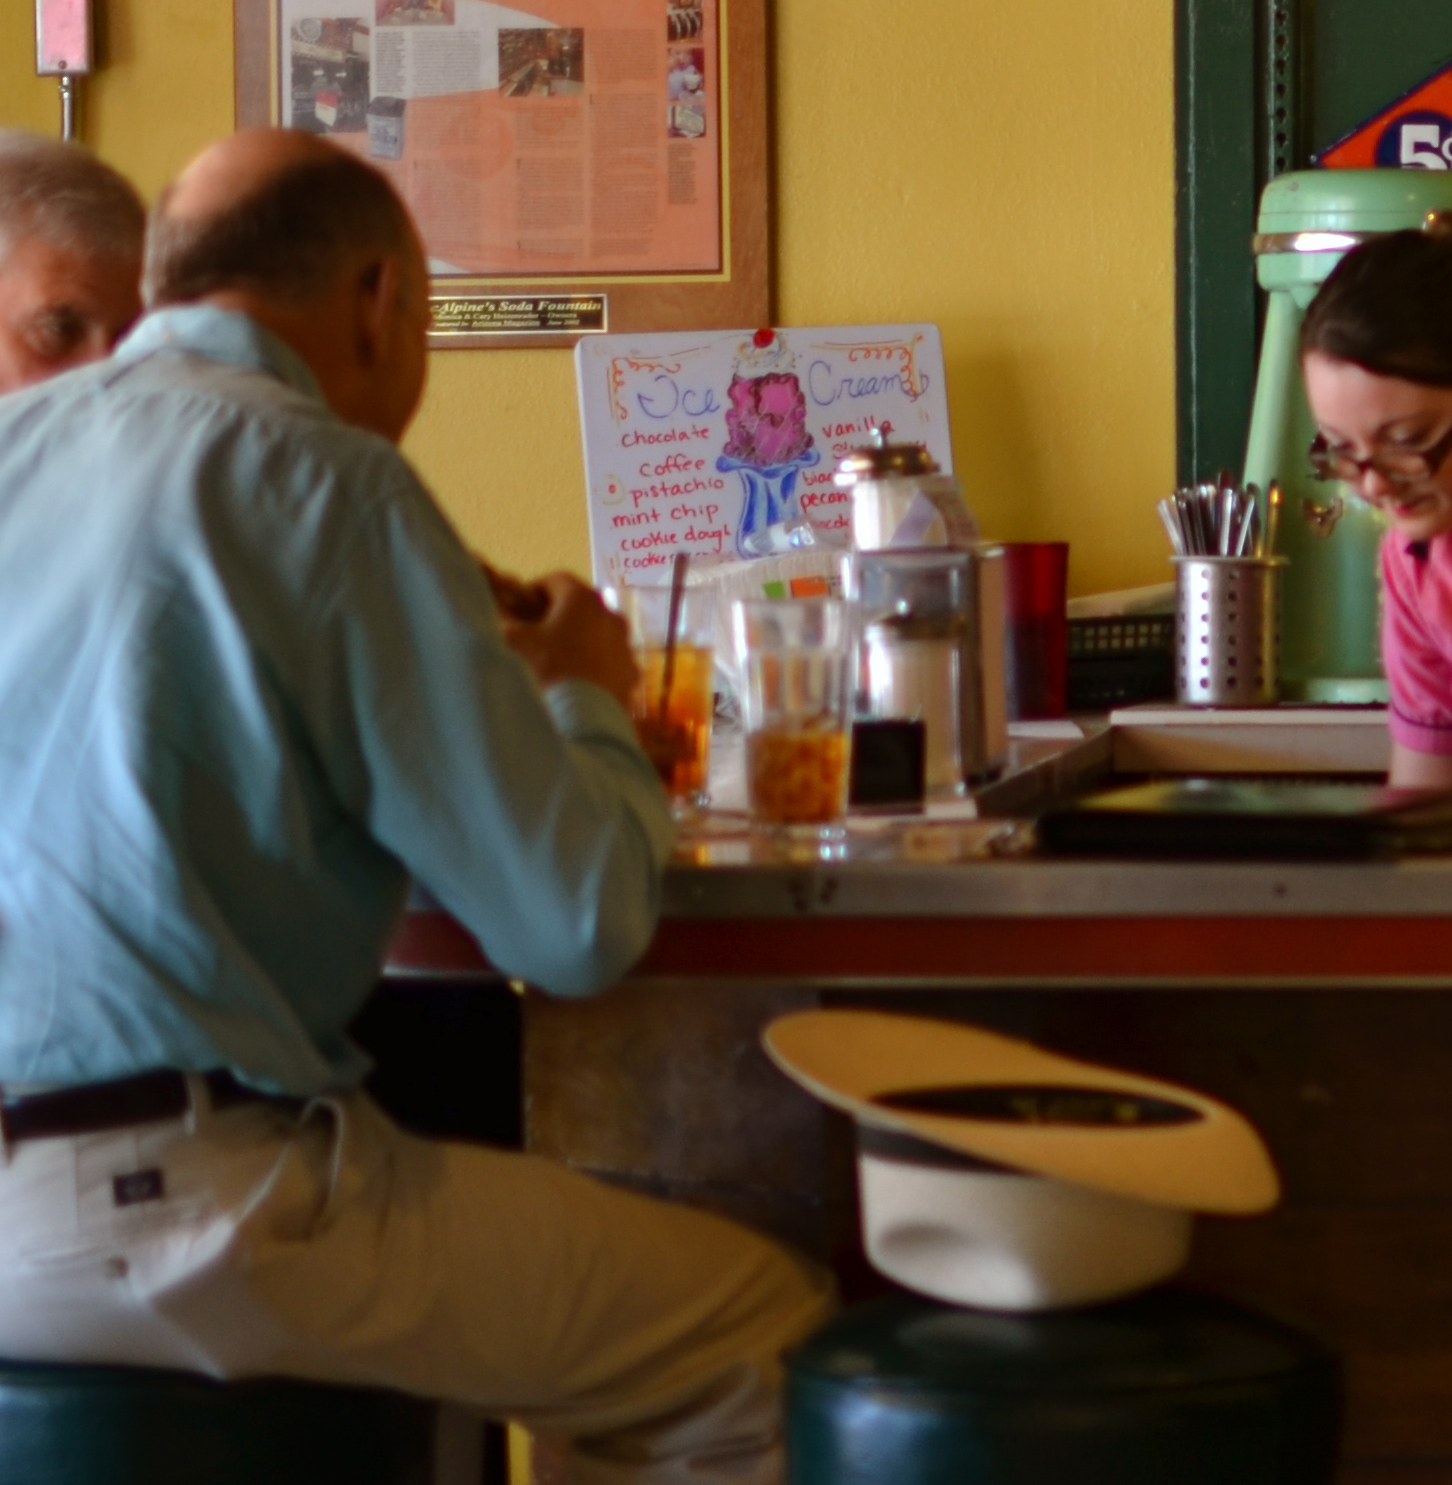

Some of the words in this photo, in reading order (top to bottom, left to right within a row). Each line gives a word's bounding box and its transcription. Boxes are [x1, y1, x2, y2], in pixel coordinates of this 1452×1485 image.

[431, 300, 496, 314] cAlpine's
[498, 300, 534, 312] Soda
[538, 299, 603, 312] Fountain
[629, 477, 724, 509] pistachio
[612, 508, 660, 528] mint
[669, 504, 719, 525] chip
[621, 530, 678, 552] cookie
